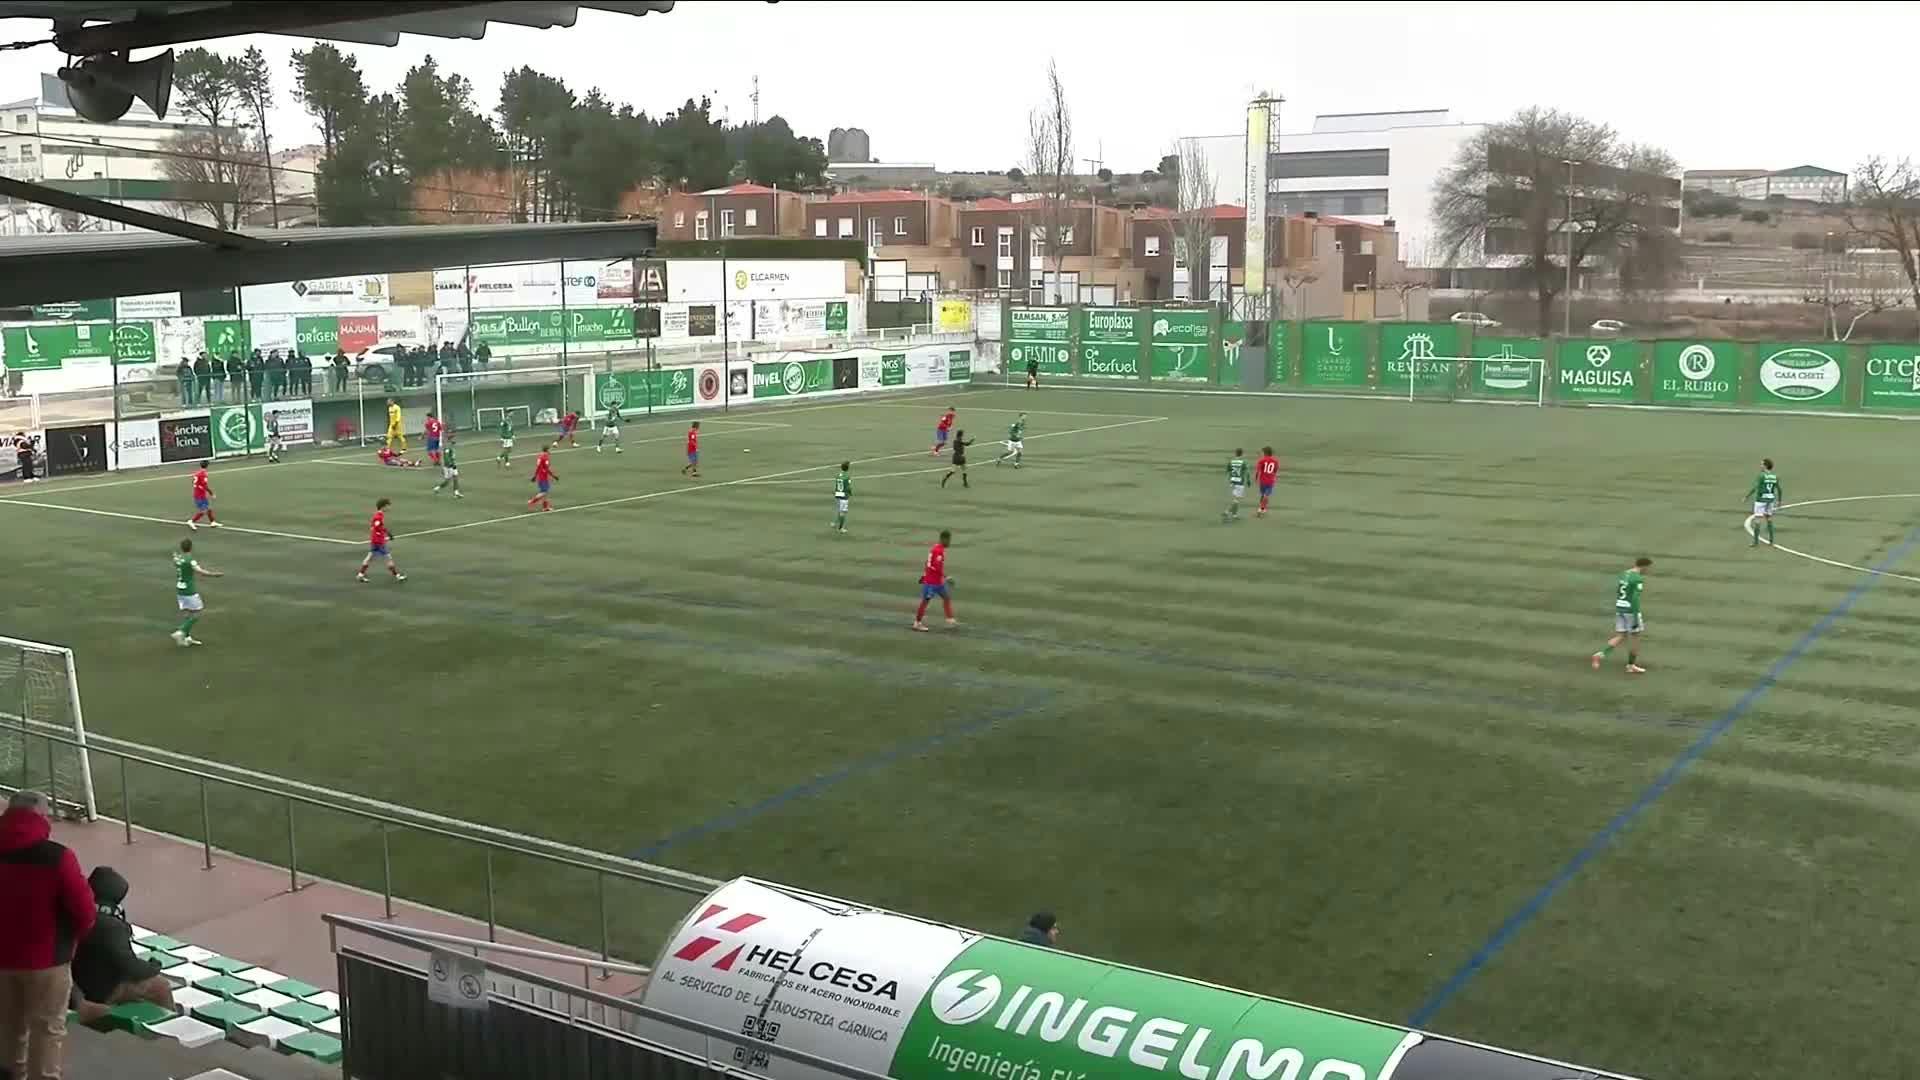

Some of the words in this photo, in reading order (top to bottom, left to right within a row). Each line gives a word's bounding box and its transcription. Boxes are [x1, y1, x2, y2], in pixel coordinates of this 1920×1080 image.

[1089, 311, 1133, 329] Europlassa
[1387, 361, 1450, 373] REVISAN
[1561, 369, 1634, 386] MAGUISA
[1663, 379, 1680, 391] EL
[1683, 380, 1729, 393] RUBIO
[123, 436, 156, 449] salcat
[1264, 462, 1275, 474] 10
[1620, 585, 1626, 599] 5
[746, 944, 901, 1001] HELCESA
[662, 970, 676, 983] AL
[679, 974, 734, 999] SERVICIO
[734, 990, 751, 1004] DE
[770, 999, 835, 1028] INDUSTRIA
[795, 984, 809, 992] EN
[809, 986, 843, 1002] ACERO
[843, 995, 902, 1018] INOXIDABLE
[928, 1035, 1041, 1080] Ingeniería
